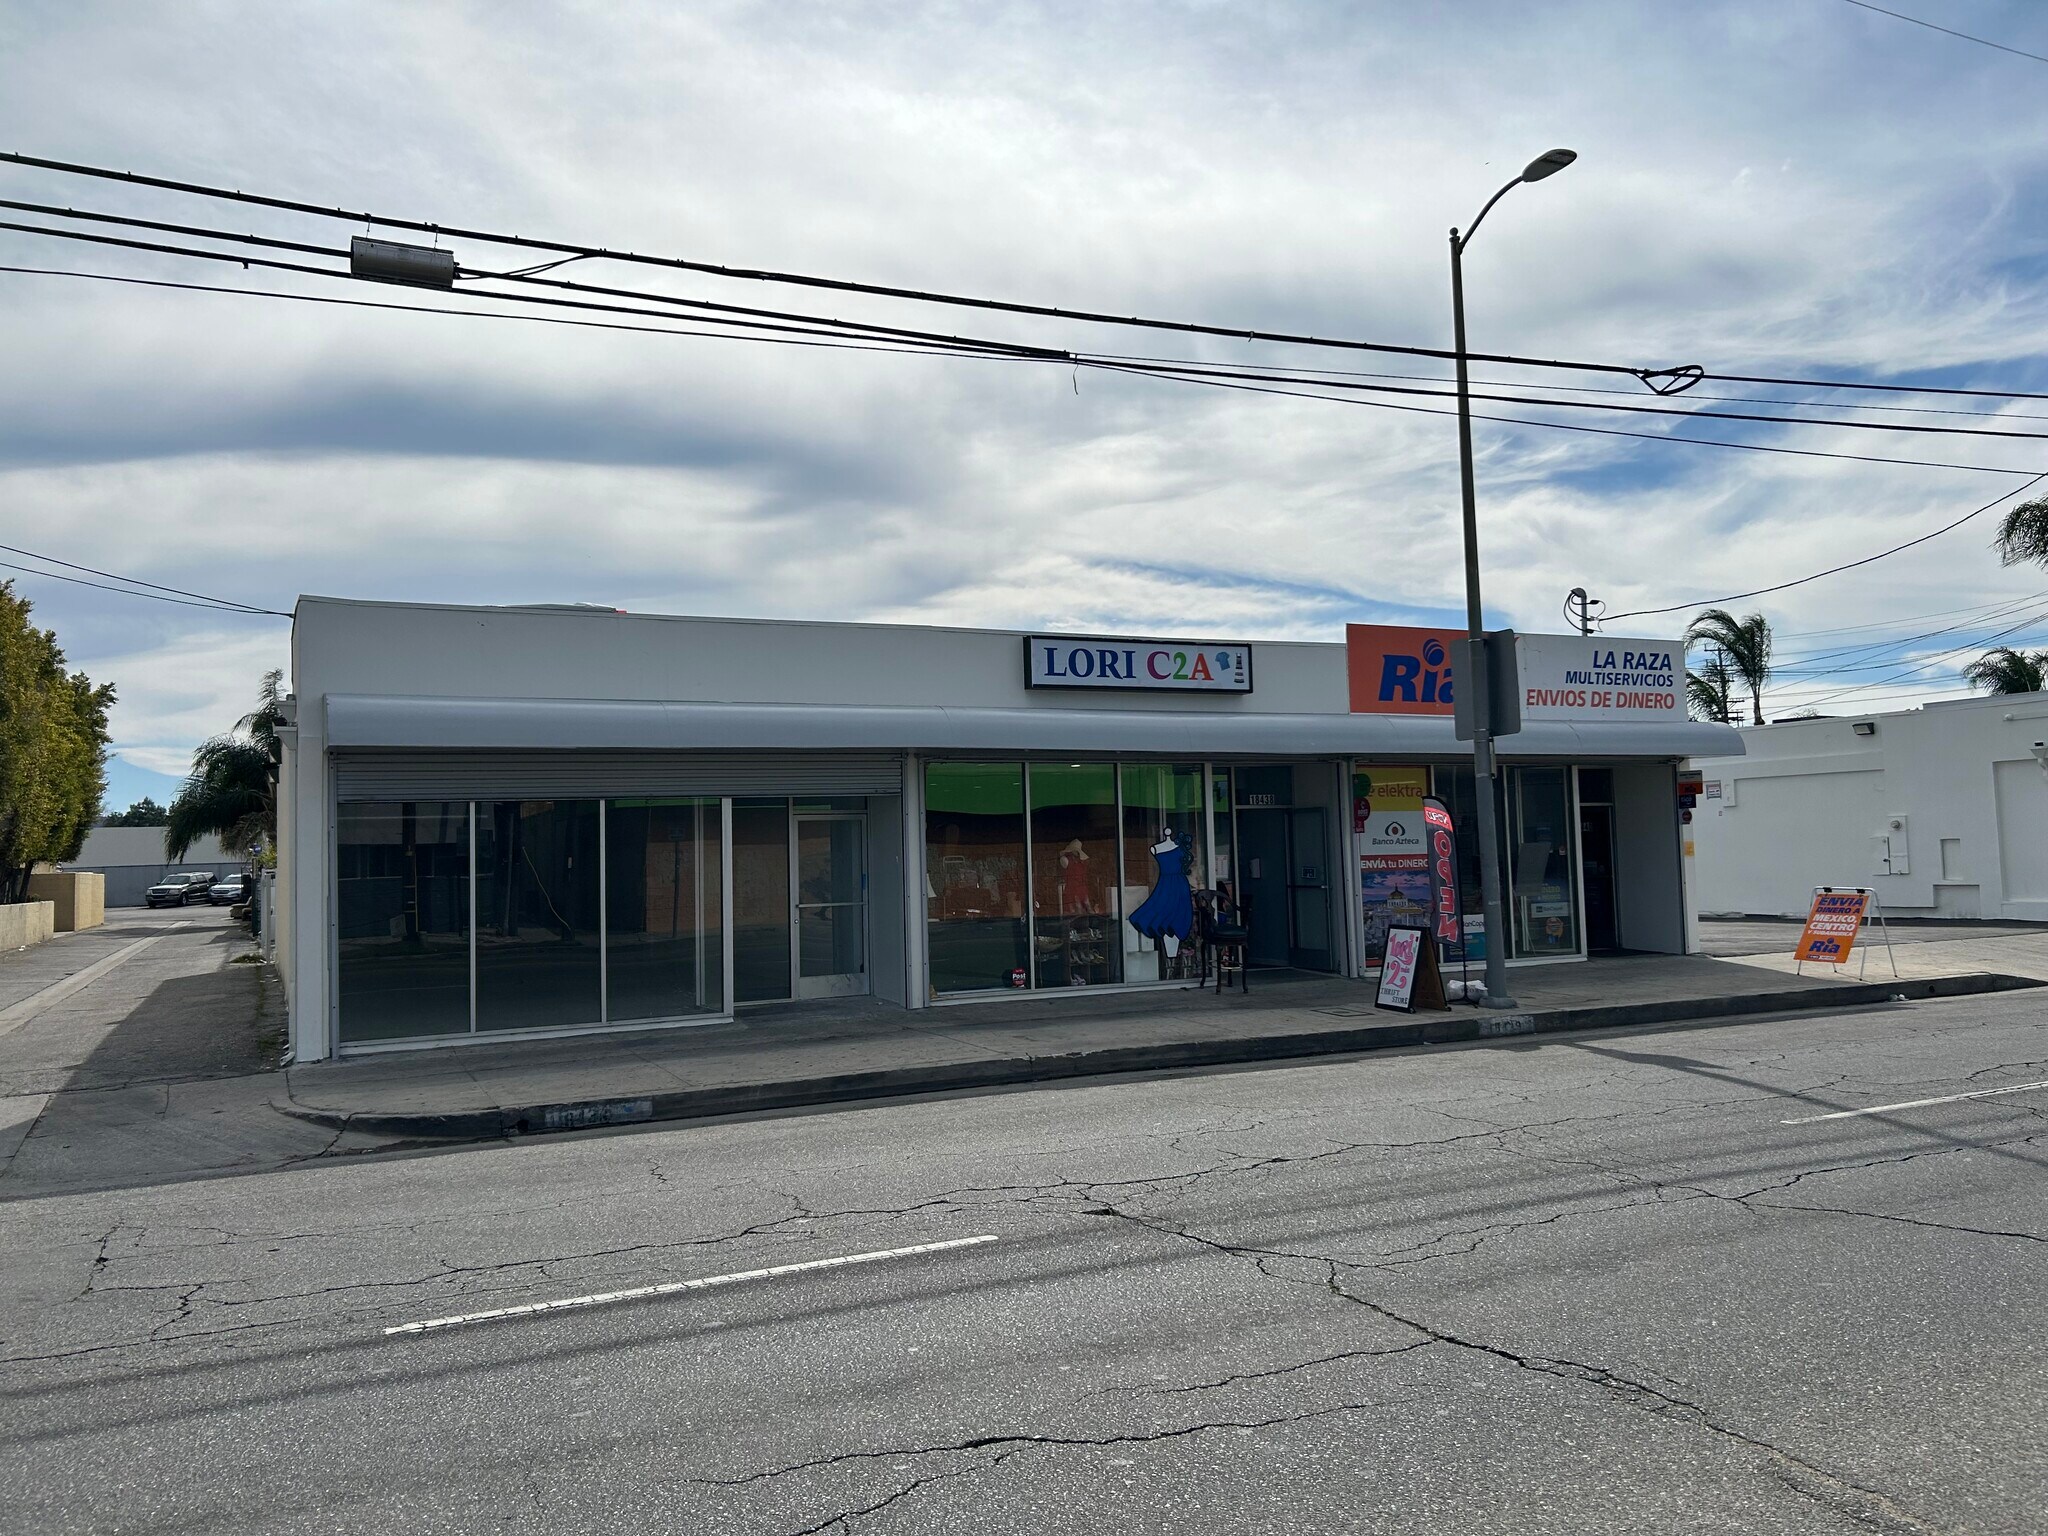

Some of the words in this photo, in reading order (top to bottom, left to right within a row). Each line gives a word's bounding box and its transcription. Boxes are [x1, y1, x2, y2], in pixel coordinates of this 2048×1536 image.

[1044, 647, 1137, 680] LORI
[1146, 650, 1215, 681] C2A
[1593, 650, 1617, 669] LA
[1622, 651, 1673, 671] RAZA
[1565, 671, 1674, 688] MULTISERVICIOS
[1526, 688, 1586, 708] ENVIOS
[1590, 690, 1612, 708] DE
[1616, 691, 1676, 710] DINERO
[1377, 783, 1423, 798] elektra
[1372, 837, 1394, 845] Banco
[1395, 837, 1420, 845] Azteca
[1388, 860, 1397, 868] tu
[1810, 922, 1855, 930] CENTRO
[1809, 938, 1840, 953] Ria
[1386, 960, 1407, 989] 2
[1391, 996, 1409, 1005] STORE
